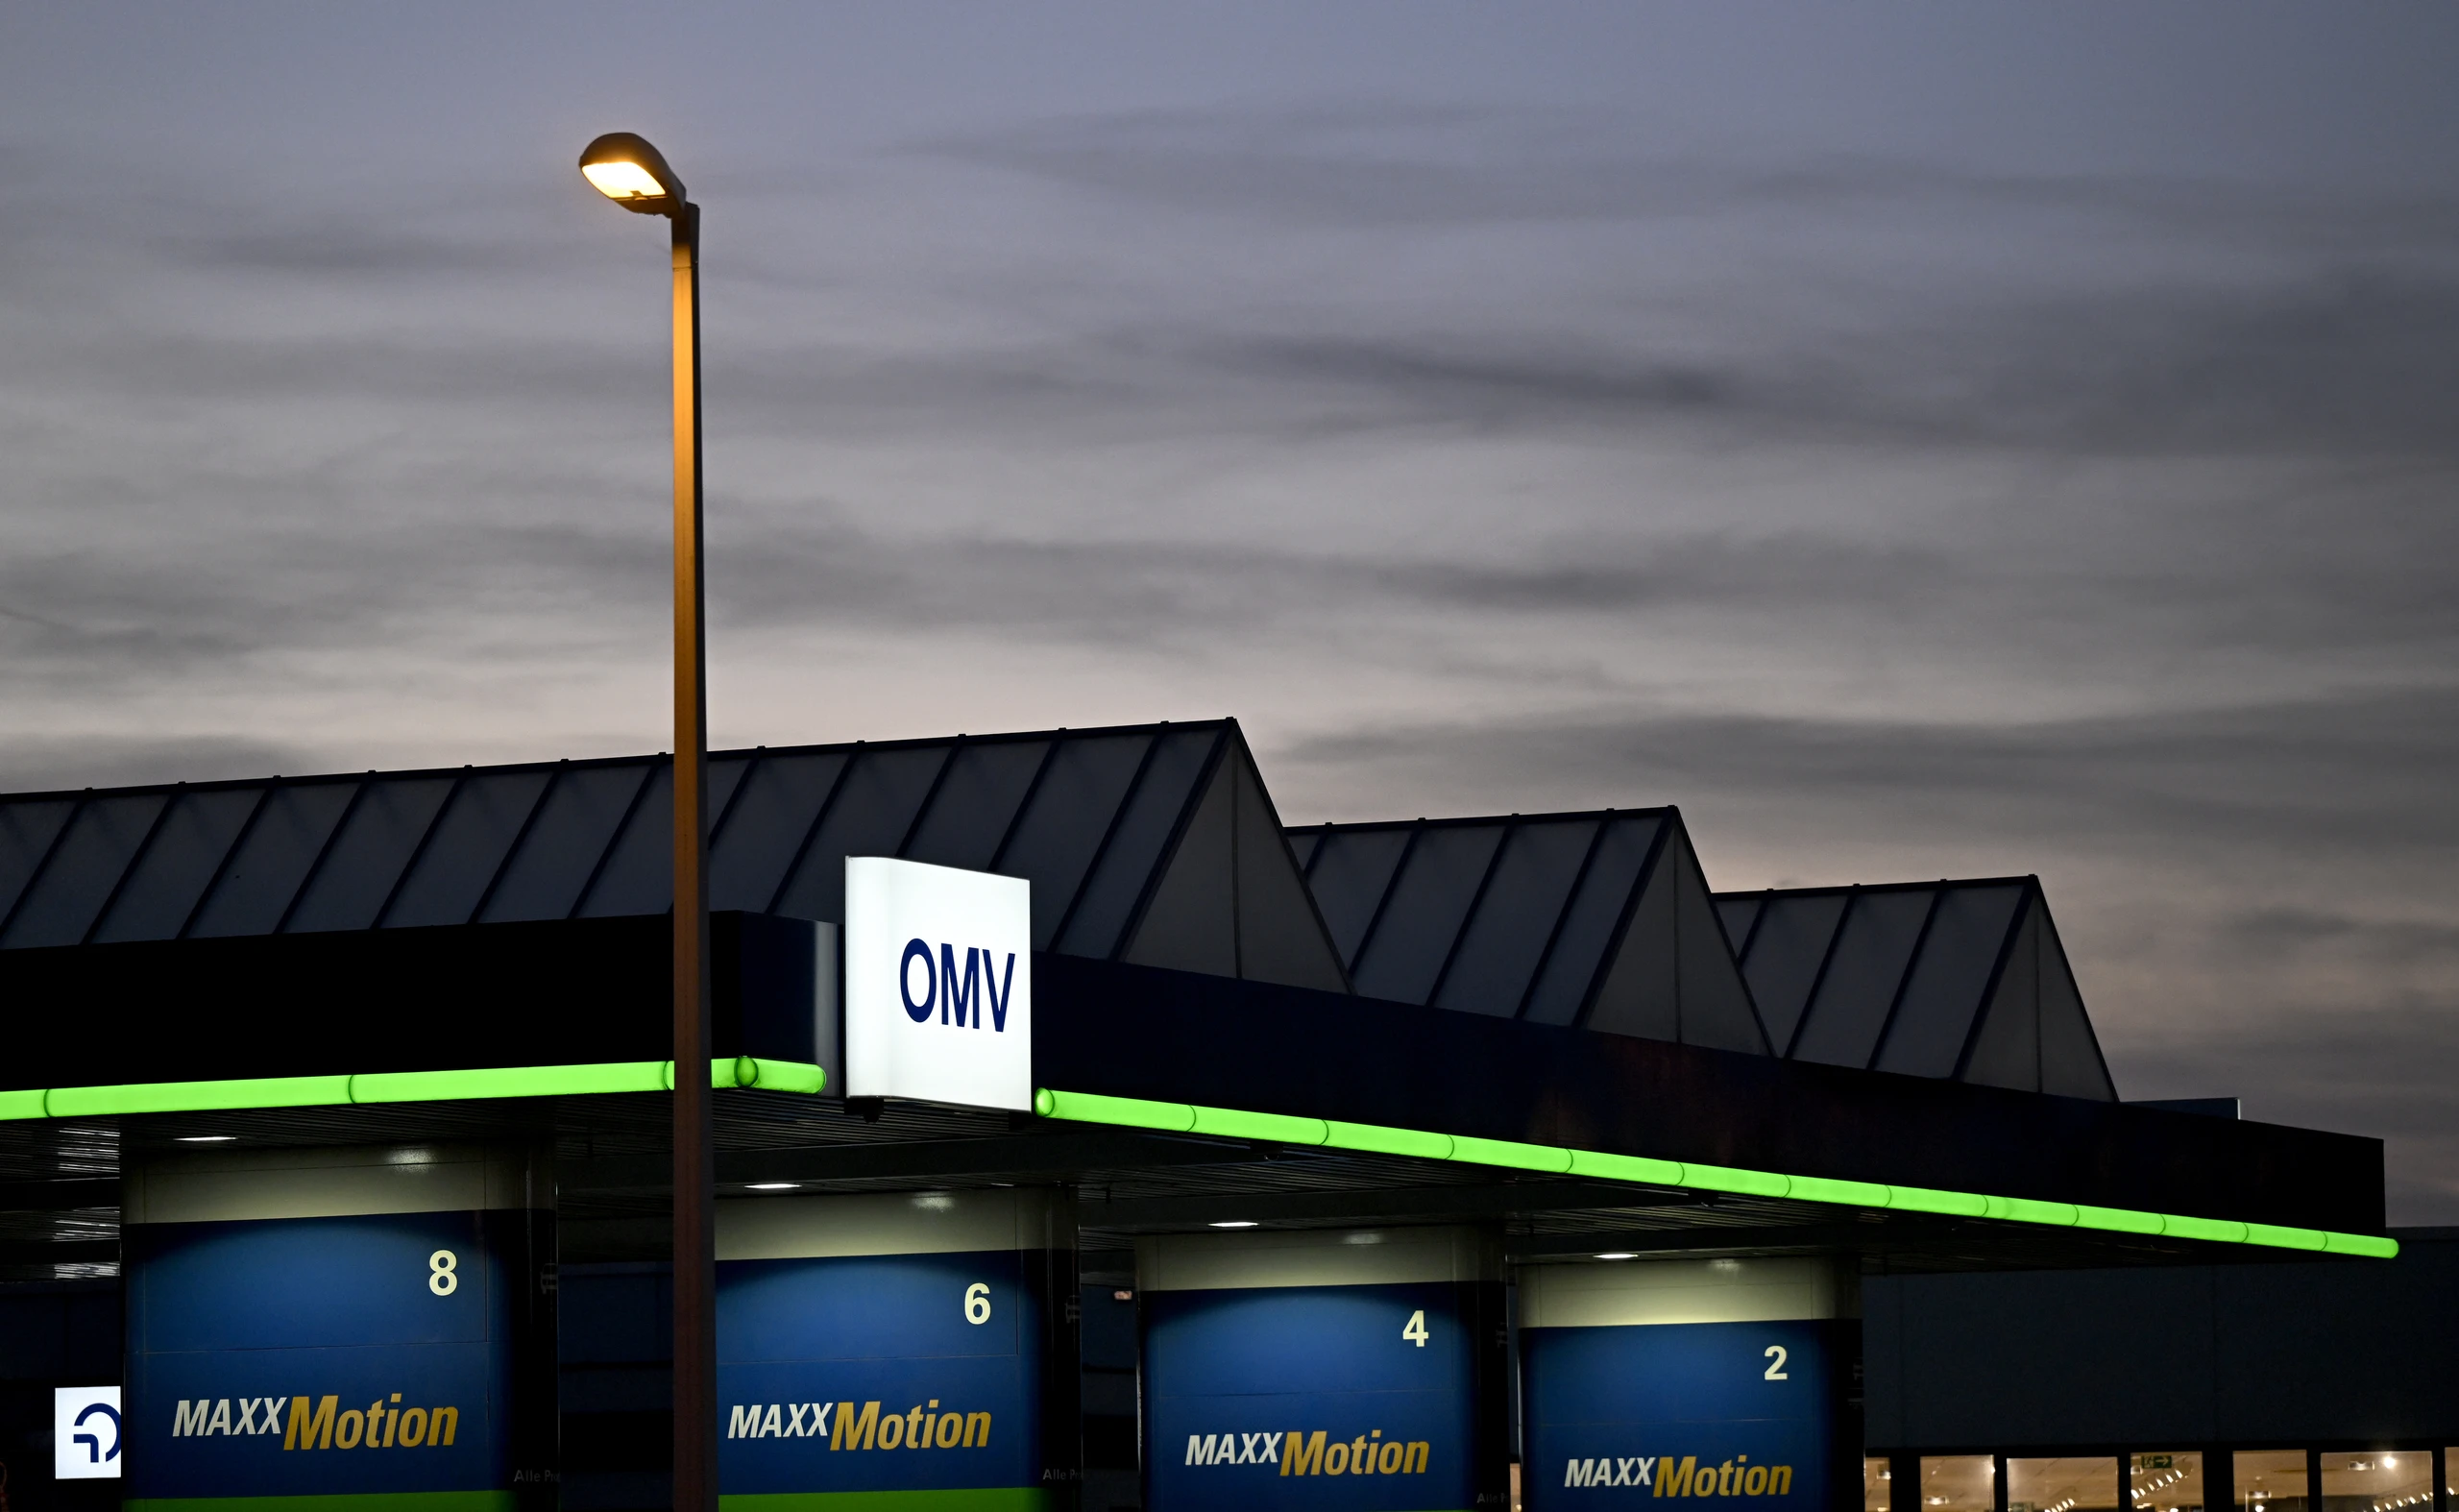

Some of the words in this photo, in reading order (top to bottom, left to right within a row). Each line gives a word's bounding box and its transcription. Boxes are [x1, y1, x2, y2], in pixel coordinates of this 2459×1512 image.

[900, 938, 1016, 1033] OMV
[428, 1250, 458, 1296] 8
[963, 1282, 991, 1326] 6
[1401, 1309, 1429, 1348] 4
[1764, 1345, 1789, 1381] 2
[513, 1469, 541, 1482] Alle
[1042, 1468, 1067, 1480] Alle
[1476, 1493, 1498, 1504] Alle
